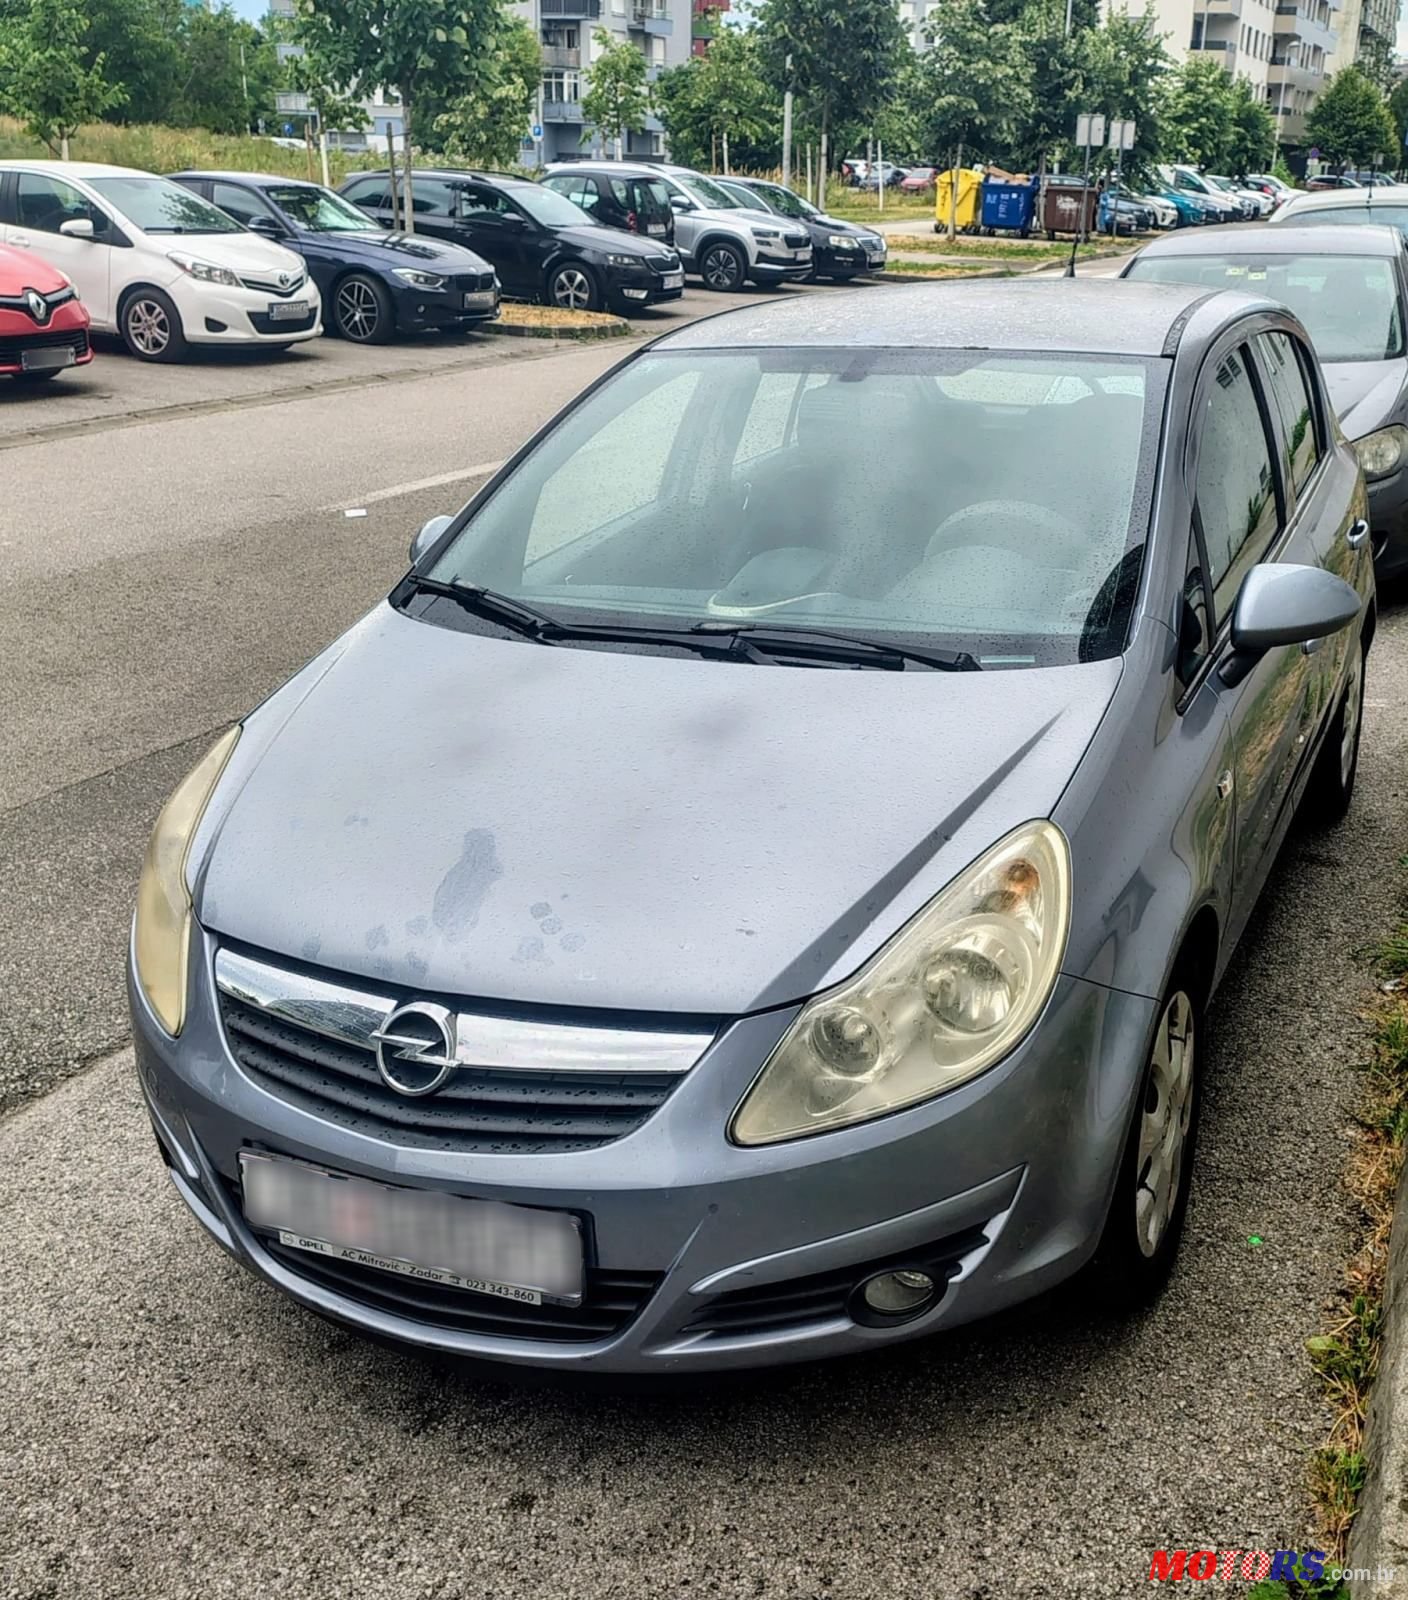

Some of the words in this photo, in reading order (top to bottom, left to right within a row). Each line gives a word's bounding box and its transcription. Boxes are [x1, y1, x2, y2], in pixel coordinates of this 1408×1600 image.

[299, 1239, 327, 1252] OPEL
[341, 1249, 356, 1259] AC
[409, 1265, 443, 1281] Zadar
[466, 1279, 487, 1291] 023
[489, 1283, 535, 1302] 343-860
